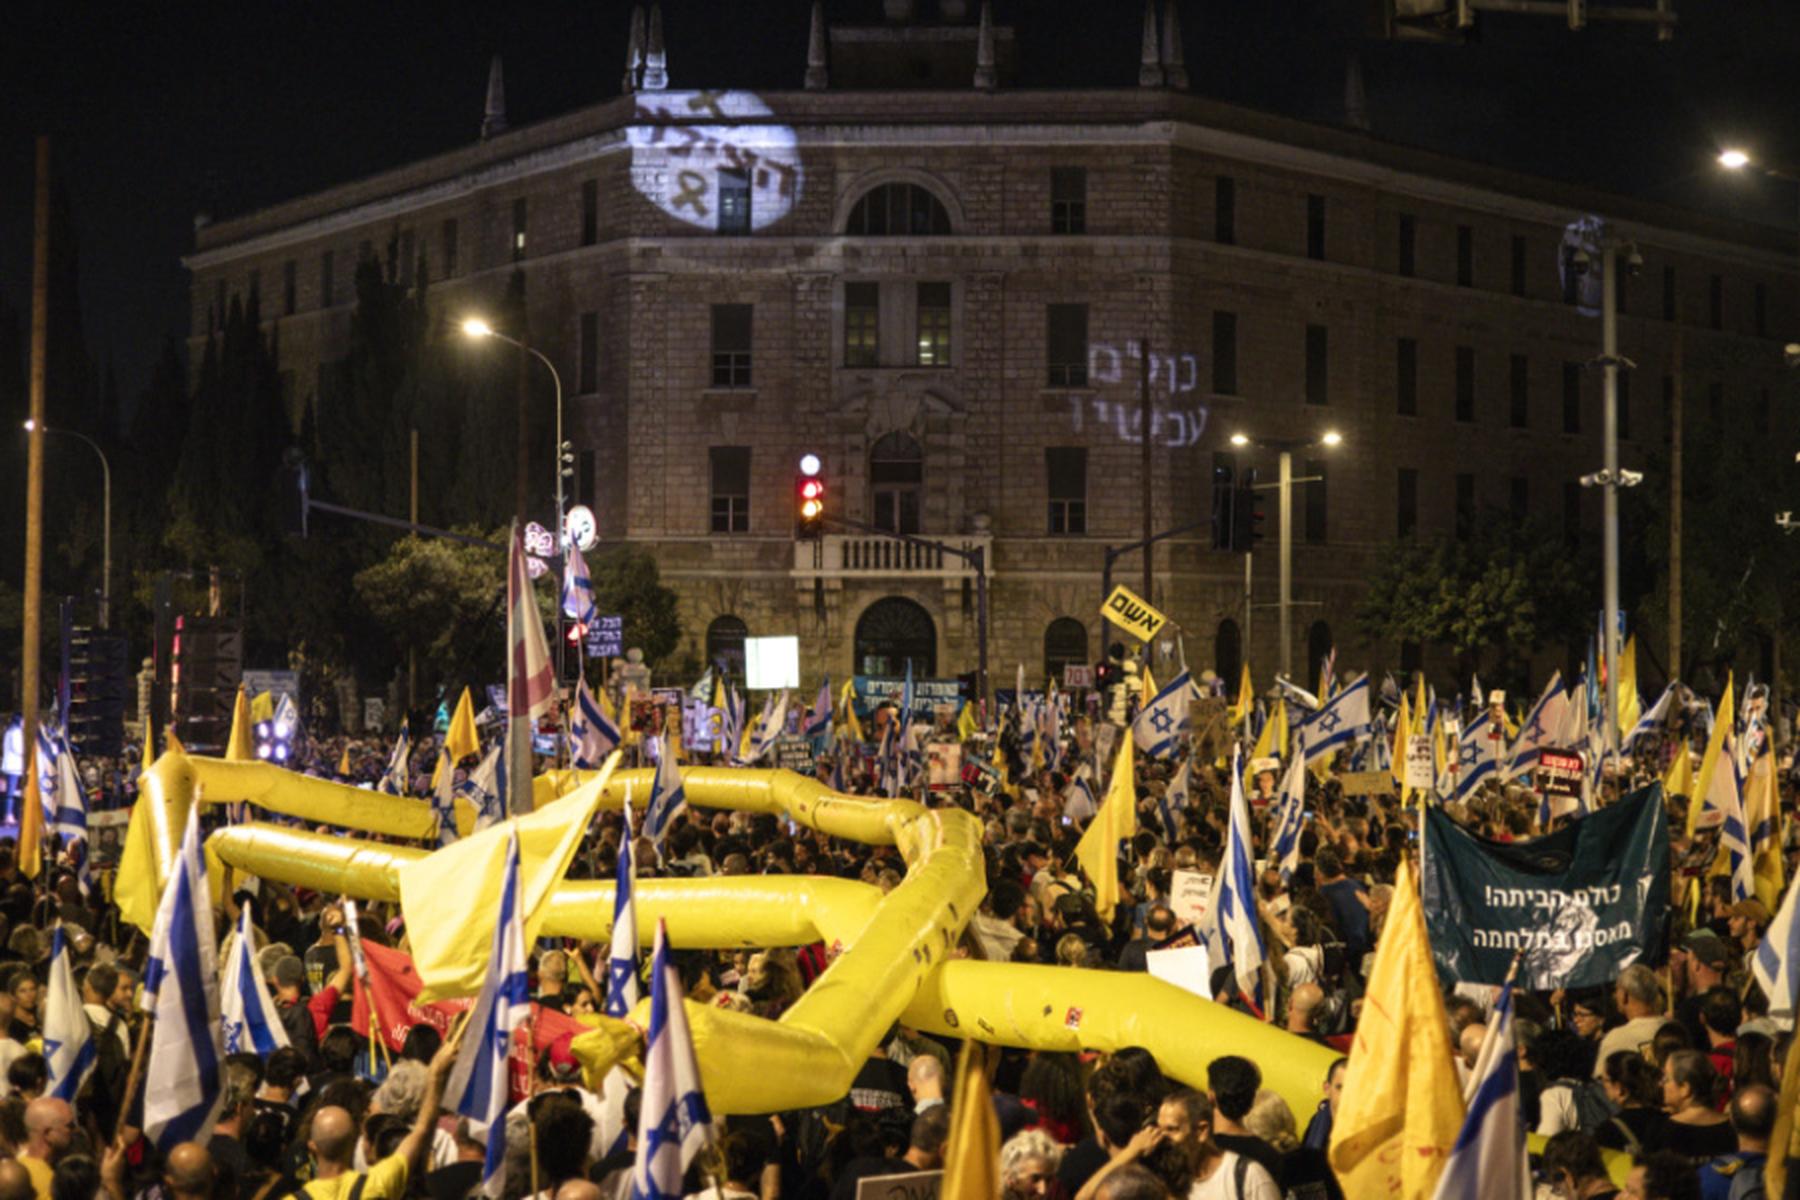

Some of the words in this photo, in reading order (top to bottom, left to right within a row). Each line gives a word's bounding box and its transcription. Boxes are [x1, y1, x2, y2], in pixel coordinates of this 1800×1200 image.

[1071, 398, 1208, 446] עכשיו
[1108, 592, 1160, 633] אשם
[1485, 885, 1565, 910] הביתה!
[1573, 883, 1622, 908] כולם
[1473, 928, 1573, 952] במלחמה
